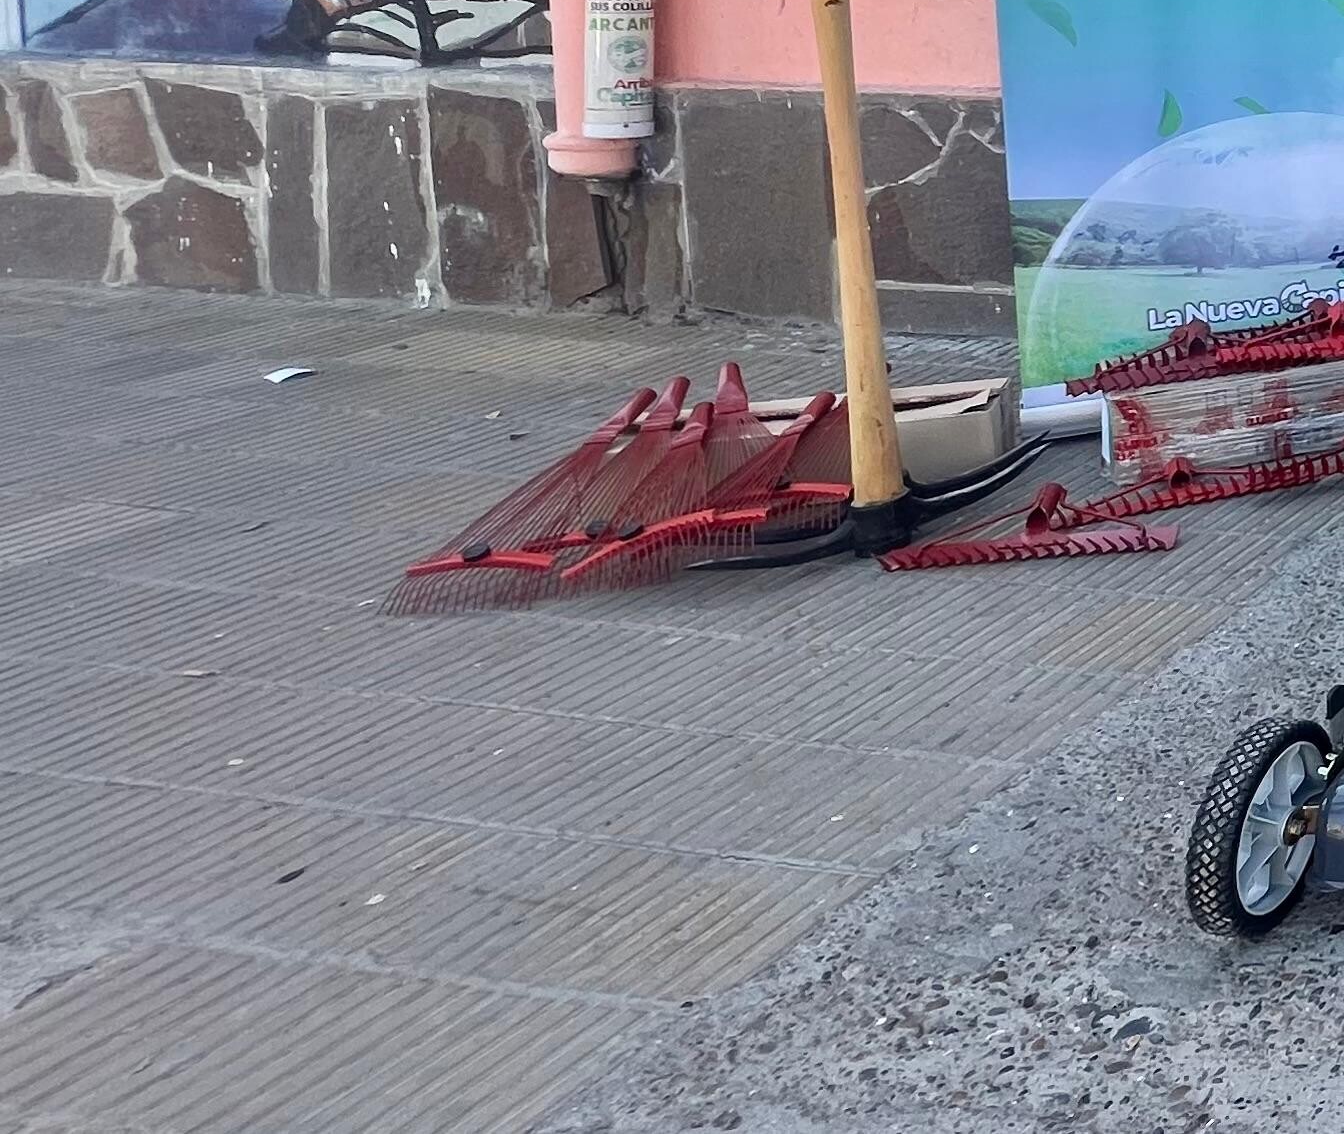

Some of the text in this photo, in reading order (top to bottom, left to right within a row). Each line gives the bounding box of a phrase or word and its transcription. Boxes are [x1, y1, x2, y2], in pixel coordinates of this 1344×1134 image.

[612, 2, 653, 12] COLILL
[1148, 306, 1184, 331] La
[1185, 295, 1281, 323] Nueva
